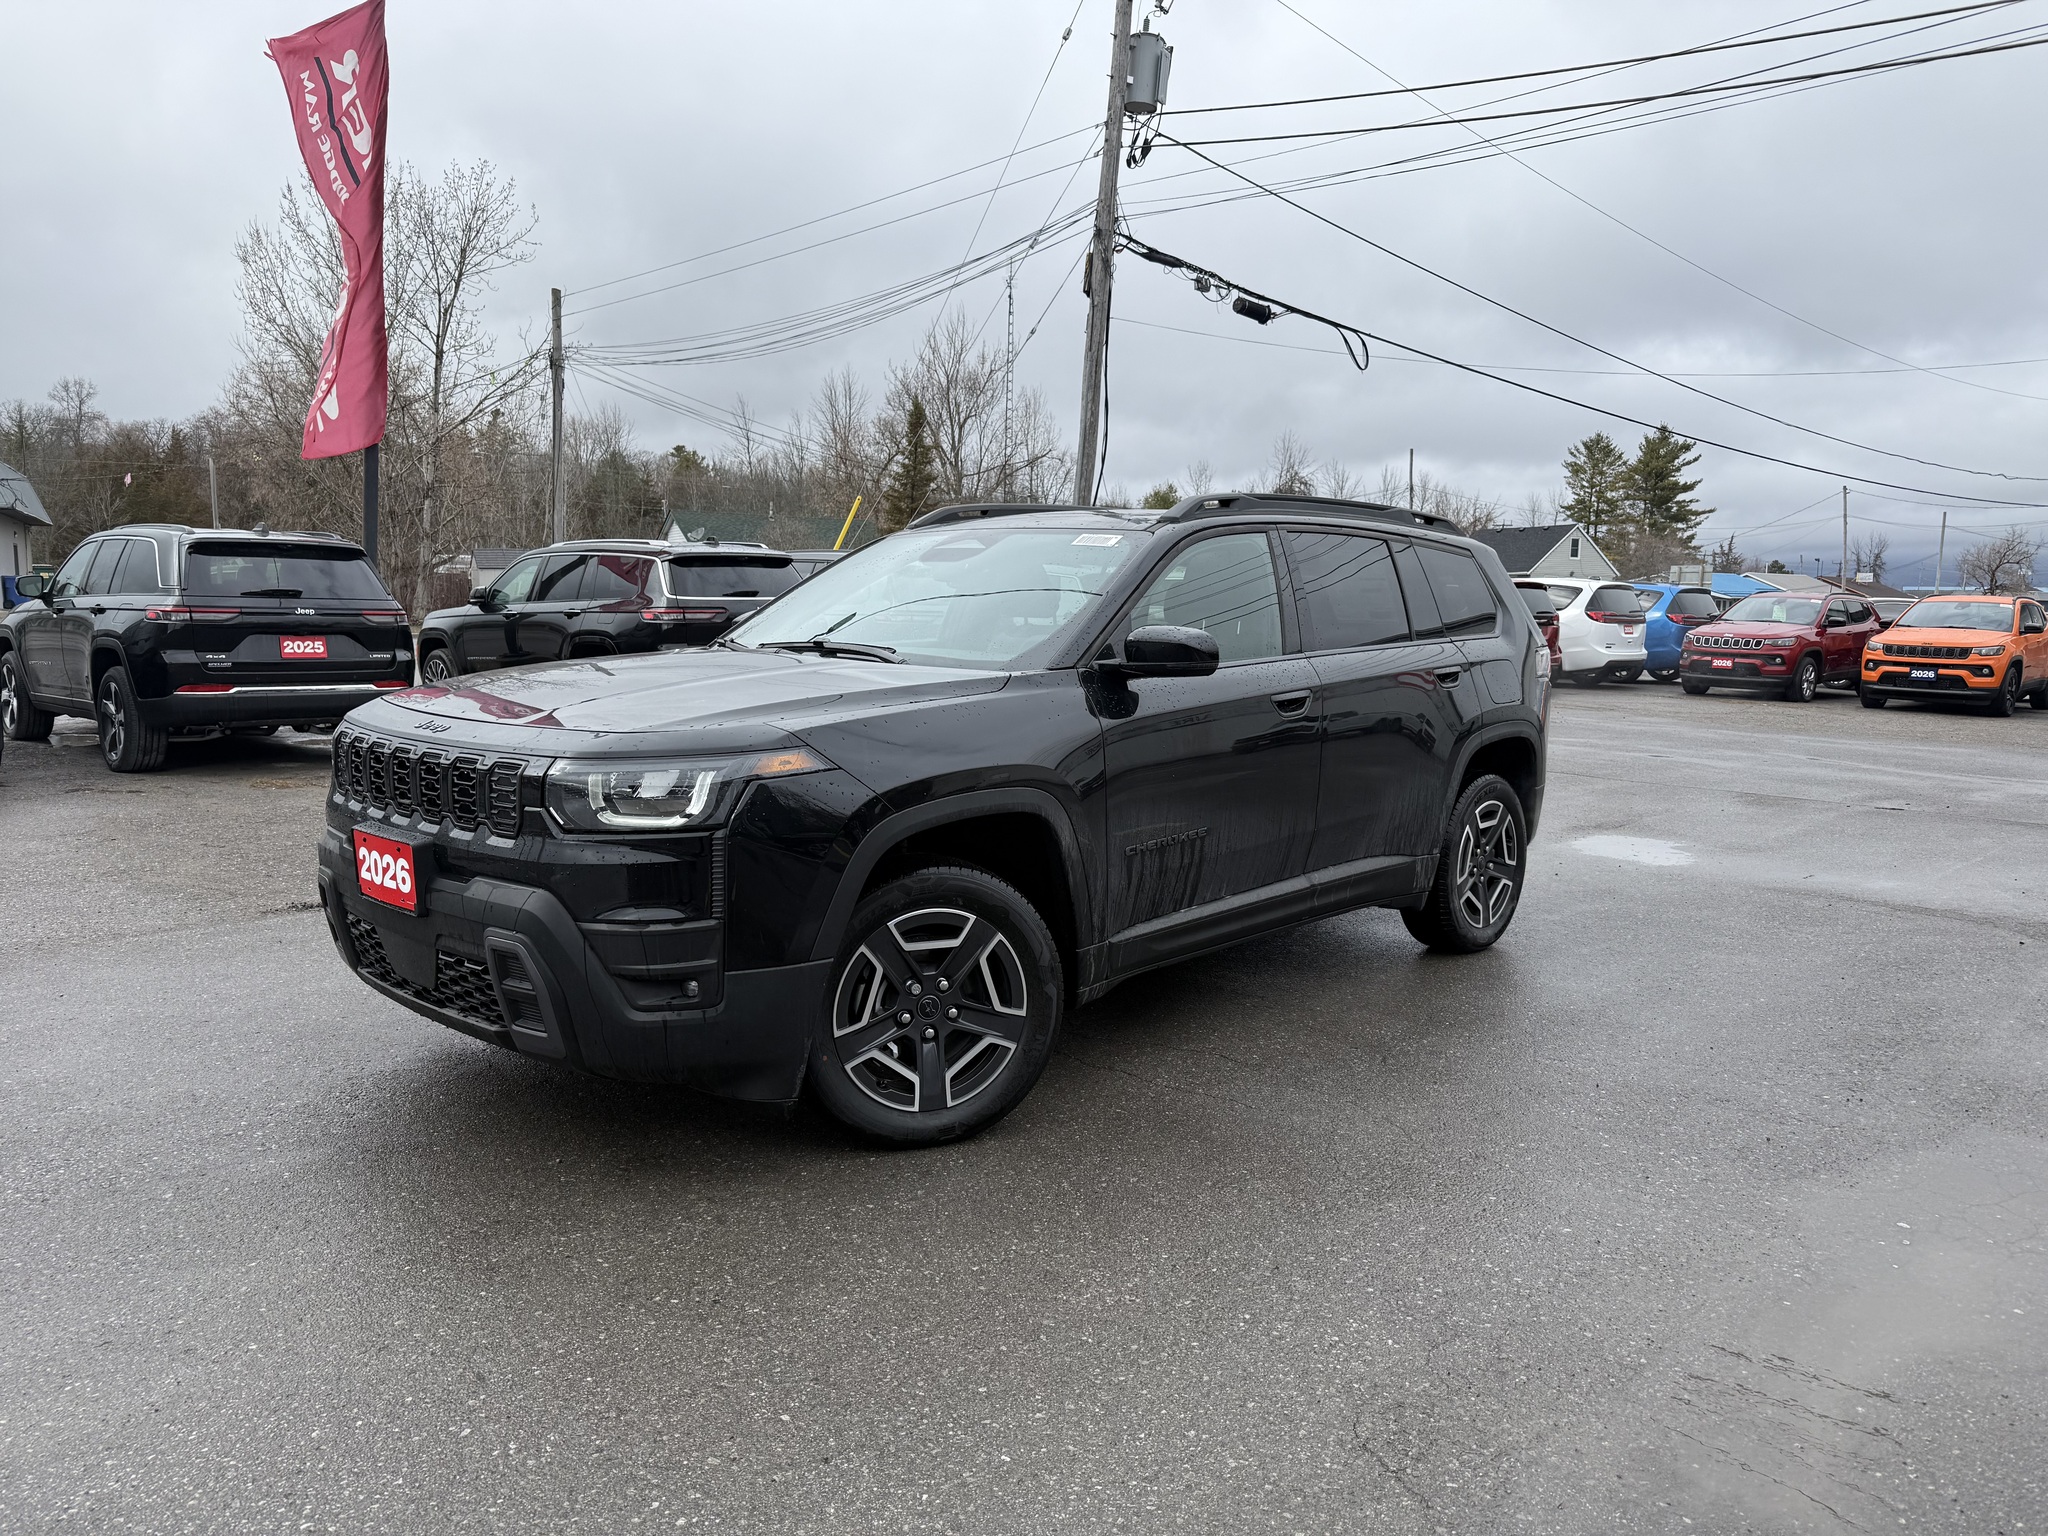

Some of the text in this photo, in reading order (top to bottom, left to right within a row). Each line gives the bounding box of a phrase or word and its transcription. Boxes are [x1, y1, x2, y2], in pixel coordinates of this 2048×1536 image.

[295, 607, 315, 615] Jeep
[283, 641, 324, 653] 2025
[1911, 670, 1935, 678] 2026
[414, 720, 451, 733] Jeep
[1125, 826, 1208, 857] CHEROKEE
[359, 846, 411, 894] 2026
